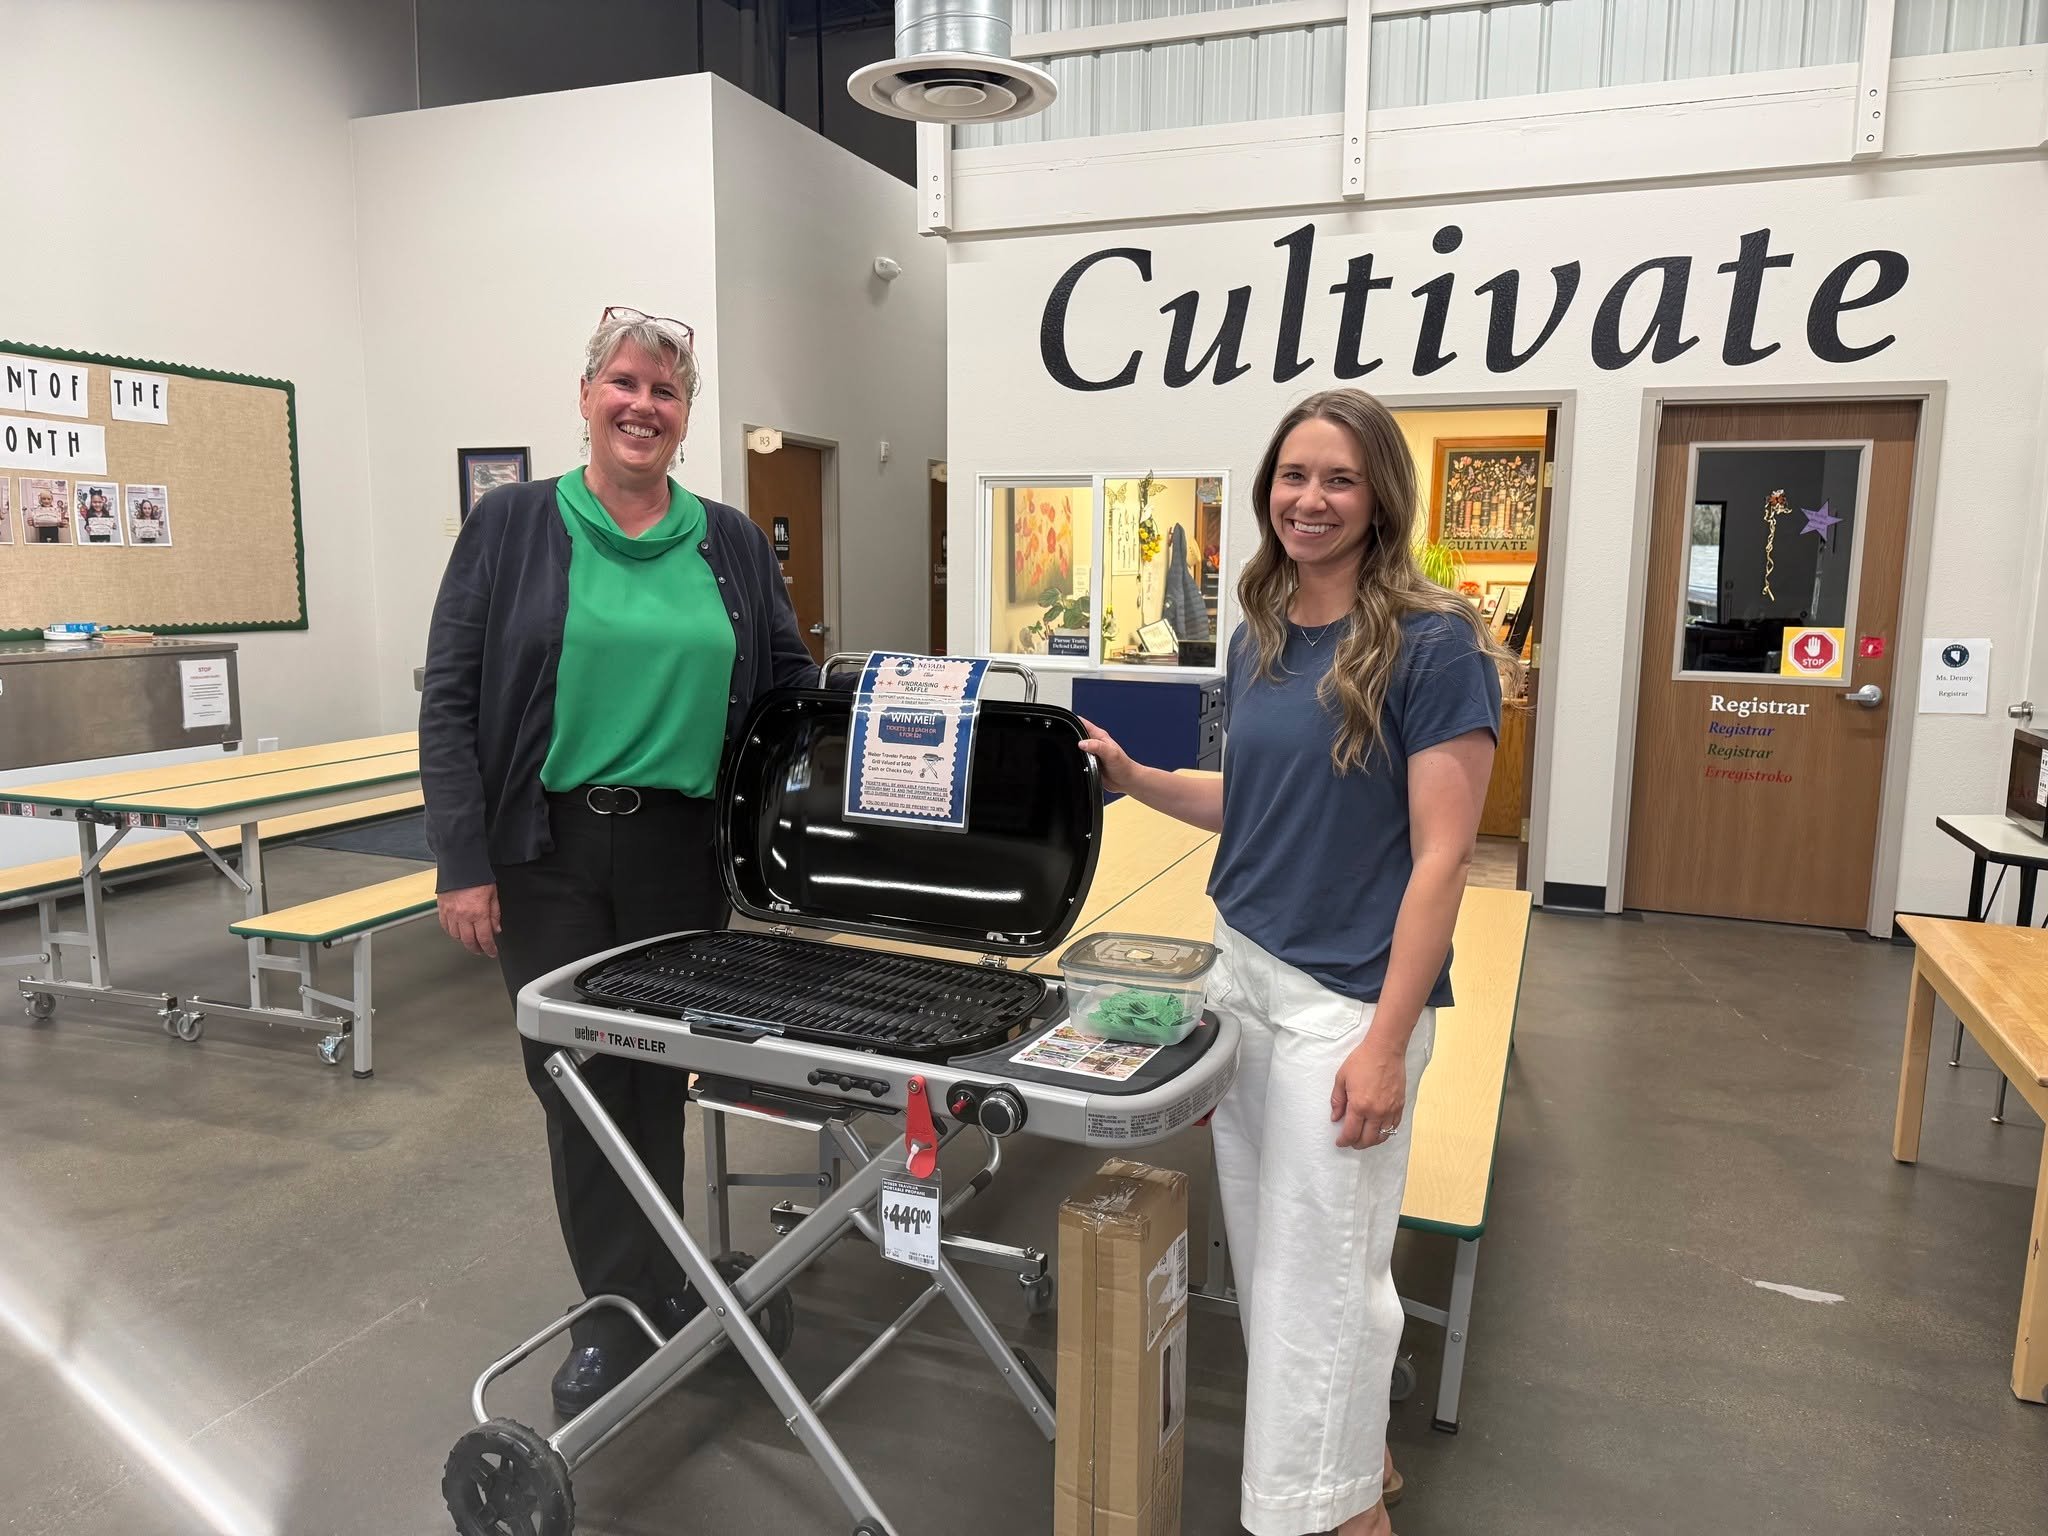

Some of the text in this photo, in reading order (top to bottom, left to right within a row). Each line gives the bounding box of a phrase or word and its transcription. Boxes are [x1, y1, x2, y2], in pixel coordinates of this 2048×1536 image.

[1040, 223, 1910, 391] Cultivate
[113, 379, 160, 410] THE
[5, 425, 80, 458] ONTH
[1448, 541, 1528, 550] CULTIVATE
[1802, 658, 1824, 668] STOP
[897, 680, 939, 688] FUNDRAISING
[1710, 694, 1810, 718] Registrar
[892, 713, 935, 725] WIN ME!!
[1708, 720, 1775, 738] Registrar
[1707, 744, 1774, 760] Registrar
[1705, 766, 1792, 784] Erregistroko
[574, 1026, 666, 1053] weber TRAVELER
